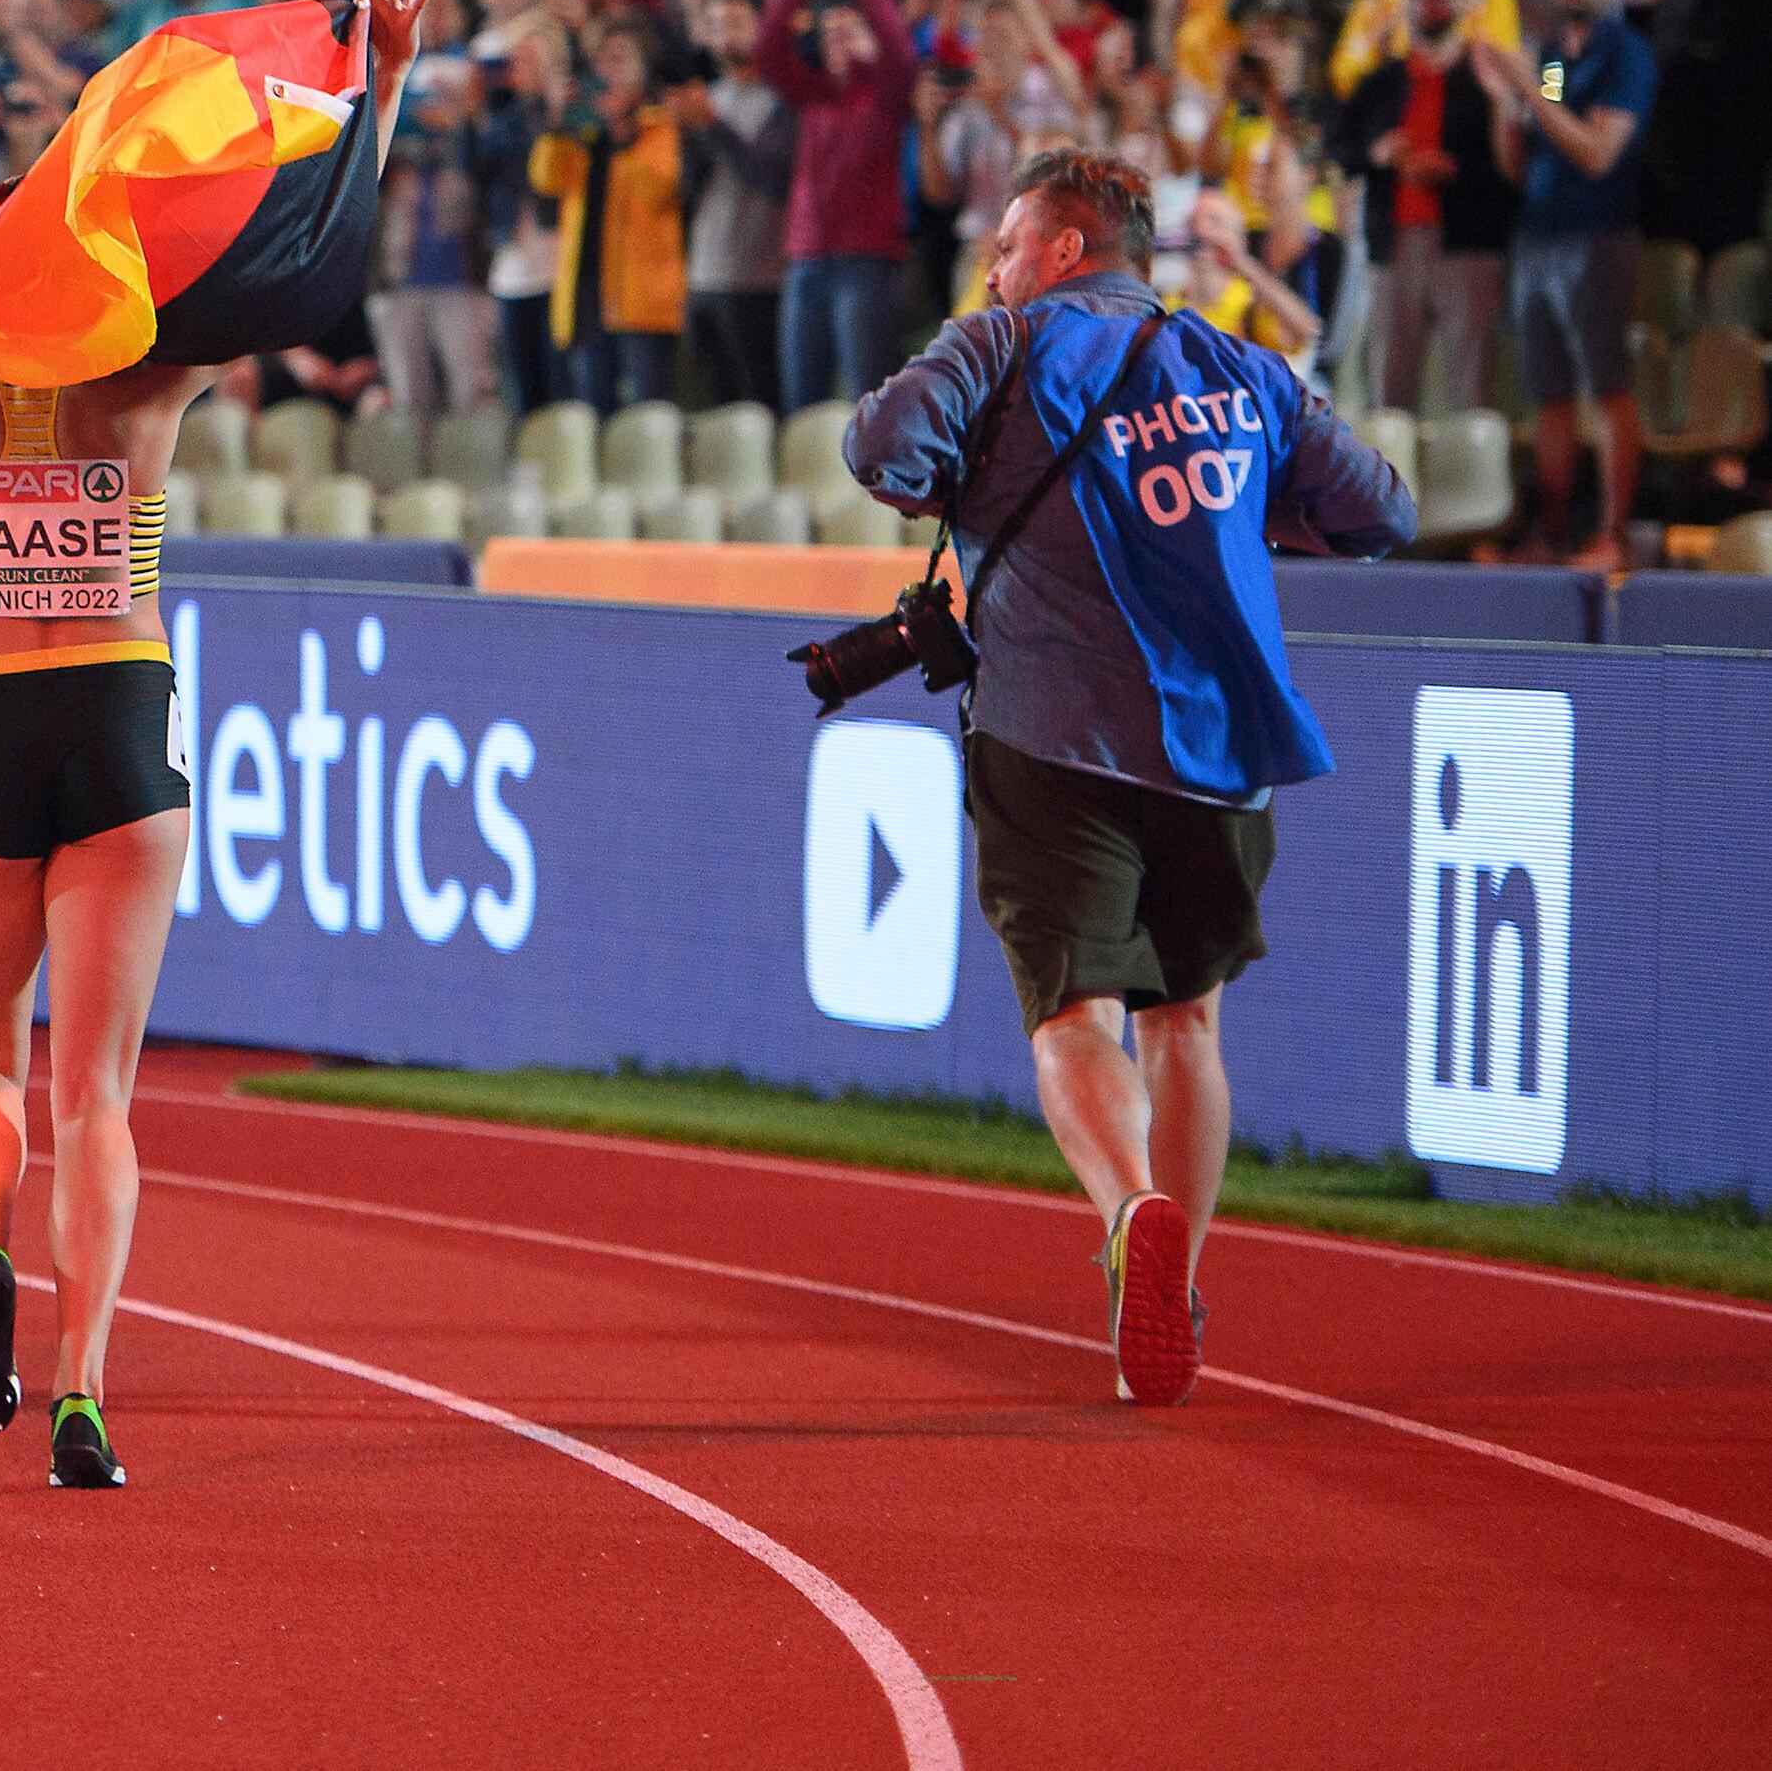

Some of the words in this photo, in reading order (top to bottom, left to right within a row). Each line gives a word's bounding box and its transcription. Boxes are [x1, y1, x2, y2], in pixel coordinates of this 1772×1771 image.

[1103, 388, 1263, 458] PHOTO
[1139, 448, 1254, 527] 007
[61, 588, 120, 610] 2022
[1434, 753, 1542, 1098] in
